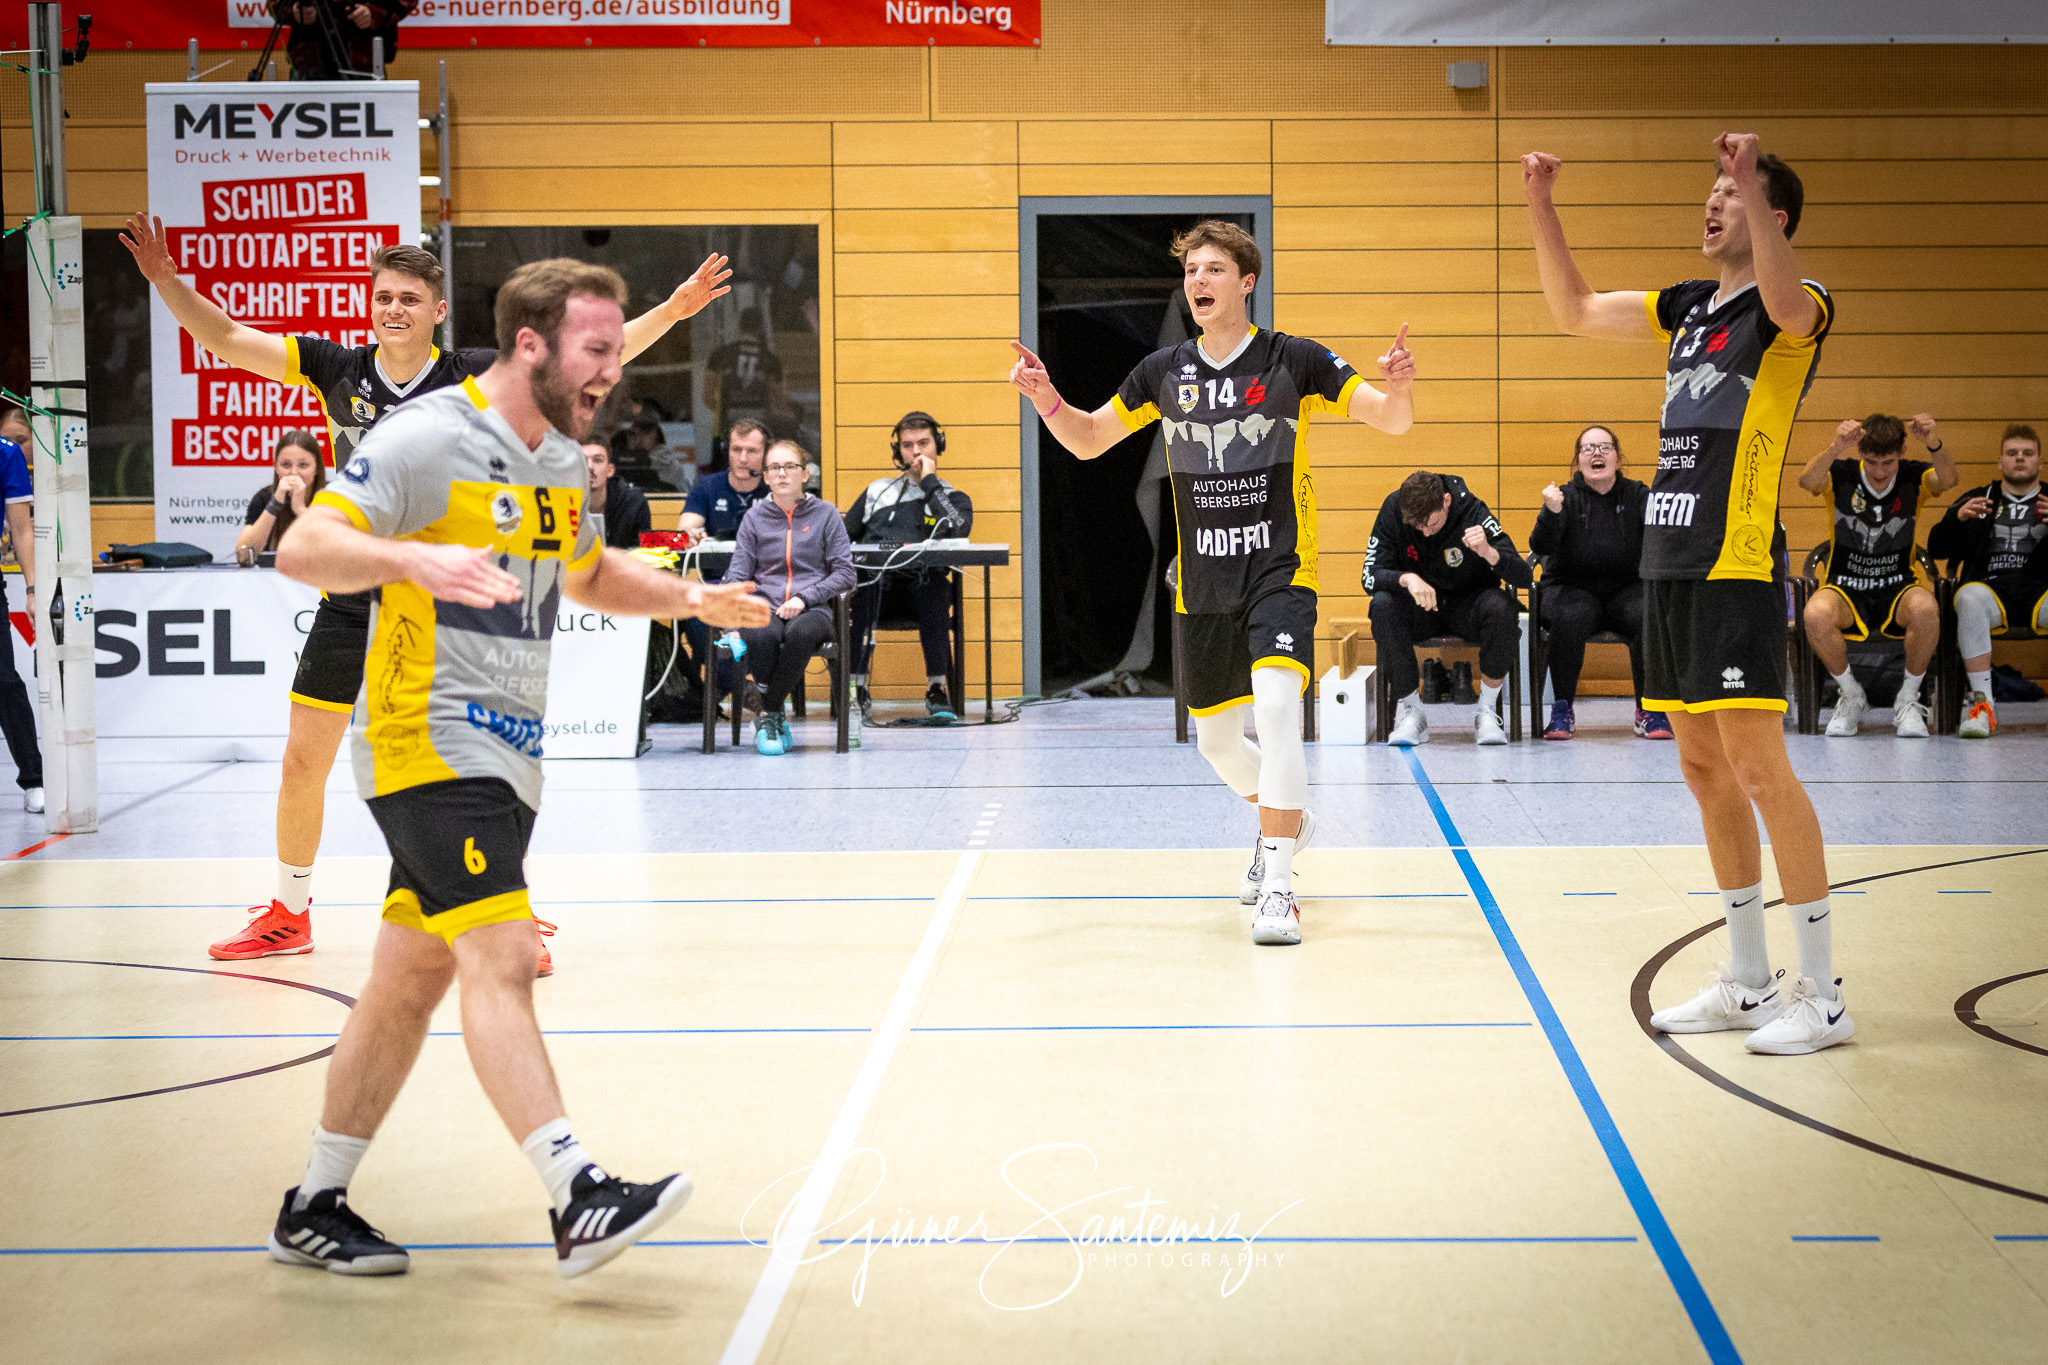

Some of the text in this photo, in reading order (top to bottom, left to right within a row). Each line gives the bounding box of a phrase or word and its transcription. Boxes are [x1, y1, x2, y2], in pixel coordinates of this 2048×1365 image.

[886, 0, 1011, 30] Nürnberg
[174, 102, 393, 139] MEYSEL
[175, 148, 391, 163] Druck + Werbetechnik
[213, 180, 355, 222] SCHILDER
[180, 232, 383, 268] FOTOTAPETEN
[211, 282, 366, 318] SCHRIFTEN
[1680, 326, 1707, 357] 3
[209, 381, 328, 417] FAHRZE
[1205, 377, 1237, 410] 14
[1193, 474, 1267, 492] AUTOHAUS
[169, 496, 250, 511] Nürnberge
[534, 486, 556, 534] 6
[1194, 490, 1267, 508] EBERSBERG
[2008, 503, 2029, 519] 17
[169, 515, 248, 526] www.mey
[1848, 552, 1900, 566] AUTOHAUS
[1990, 554, 2029, 564] AUTOH
[92, 608, 265, 679] SEL
[543, 720, 618, 738] eysel.de
[464, 837, 487, 875] 6
